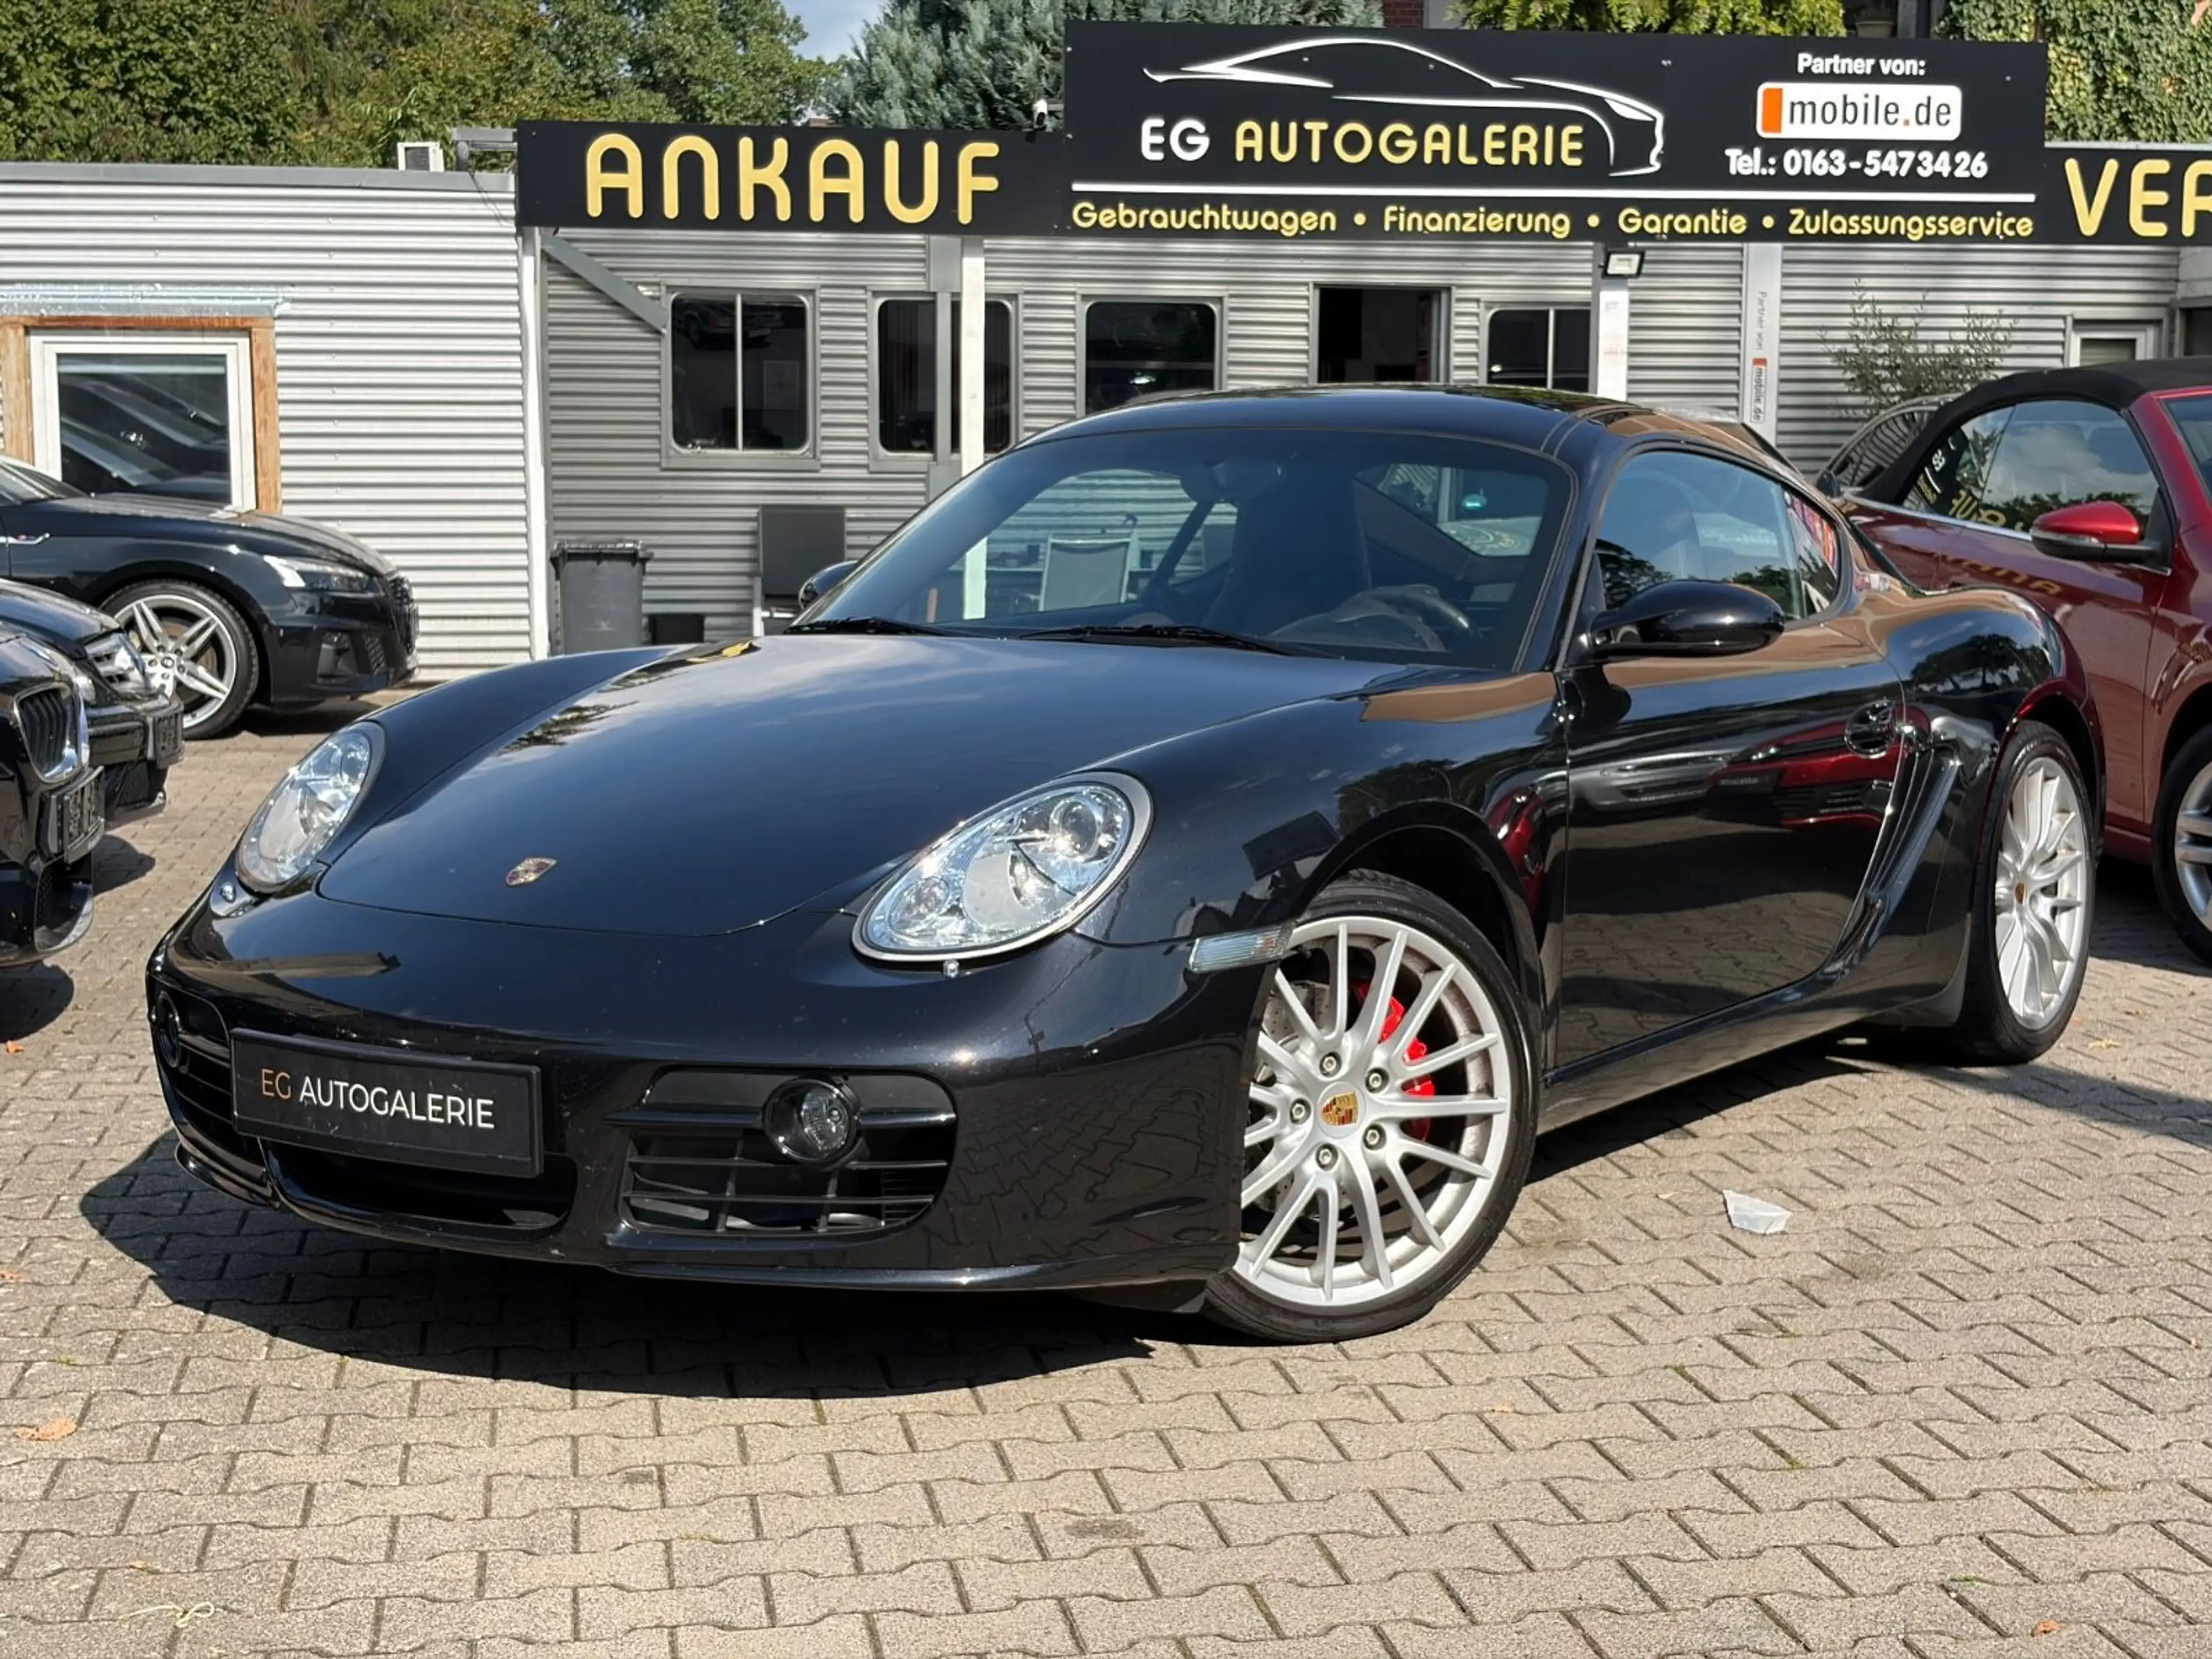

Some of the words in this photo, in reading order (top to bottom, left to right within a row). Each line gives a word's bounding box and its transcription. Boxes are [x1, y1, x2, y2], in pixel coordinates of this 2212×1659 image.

[1797, 52, 1876, 75] Partner
[1878, 58, 1926, 76] von:
[1789, 93, 1952, 127] mobile.de
[1141, 117, 1210, 161] EG
[1235, 120, 1584, 166] AUTOGALERIE
[1724, 146, 1777, 176] Tel.:
[586, 132, 999, 225] ANKAUF
[1071, 201, 1336, 237] Gebrauchtwagen
[1384, 204, 1571, 238] Finanzierung
[1618, 207, 1747, 234] Garantie
[1788, 208, 2033, 241] Zulassungsservice
[262, 1069, 291, 1100] EG
[299, 1075, 495, 1129] AUTOGALERIE
